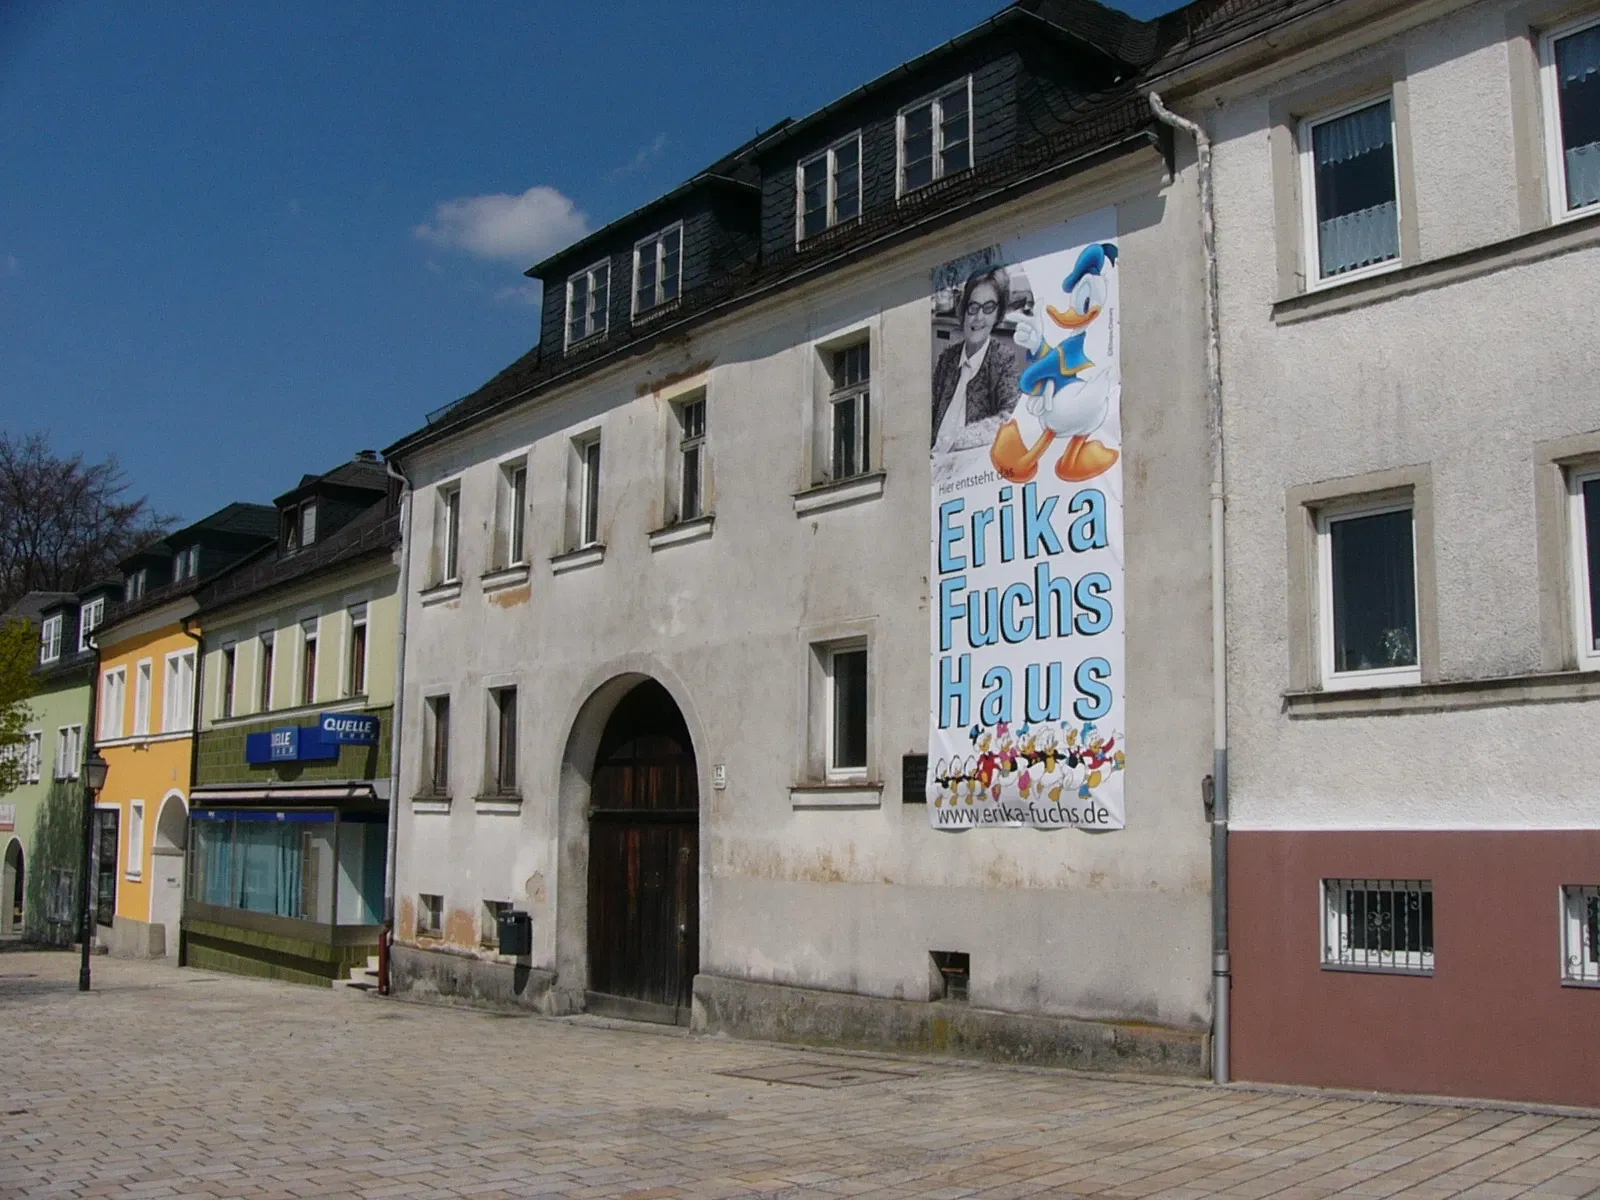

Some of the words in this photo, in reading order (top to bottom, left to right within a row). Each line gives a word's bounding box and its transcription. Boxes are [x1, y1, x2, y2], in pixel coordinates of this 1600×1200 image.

[938, 483, 954, 496] Hier
[955, 470, 994, 490] entsteht
[997, 466, 1015, 481] das
[938, 482, 1110, 575] Erika
[938, 562, 1113, 652] Fuchs
[938, 652, 1113, 729] Haus
[323, 717, 372, 733] QUELLE
[937, 801, 1110, 825] www.erika-fuchs.de
